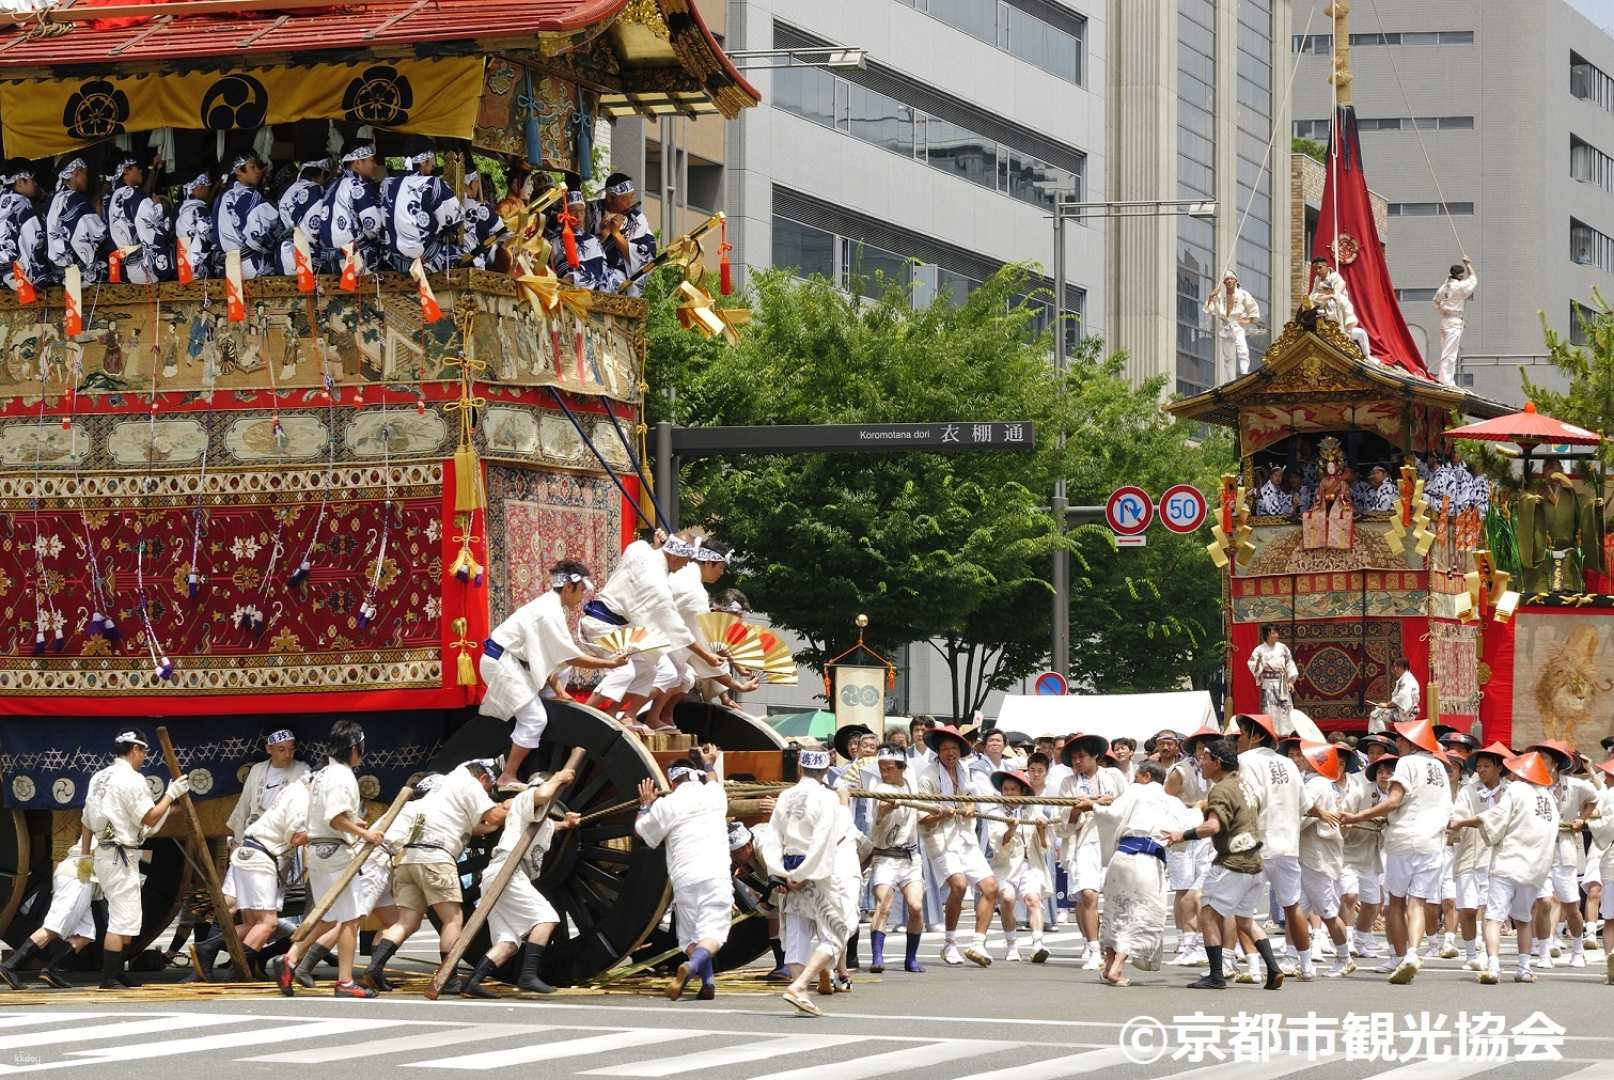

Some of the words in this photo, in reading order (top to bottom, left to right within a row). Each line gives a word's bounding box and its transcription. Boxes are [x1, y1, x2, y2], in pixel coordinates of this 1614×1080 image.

[860, 430, 912, 440] Koromotana
[913, 429, 931, 439] dori
[940, 423, 1024, 442] 衣棚通
[1170, 498, 1196, 520] 50
